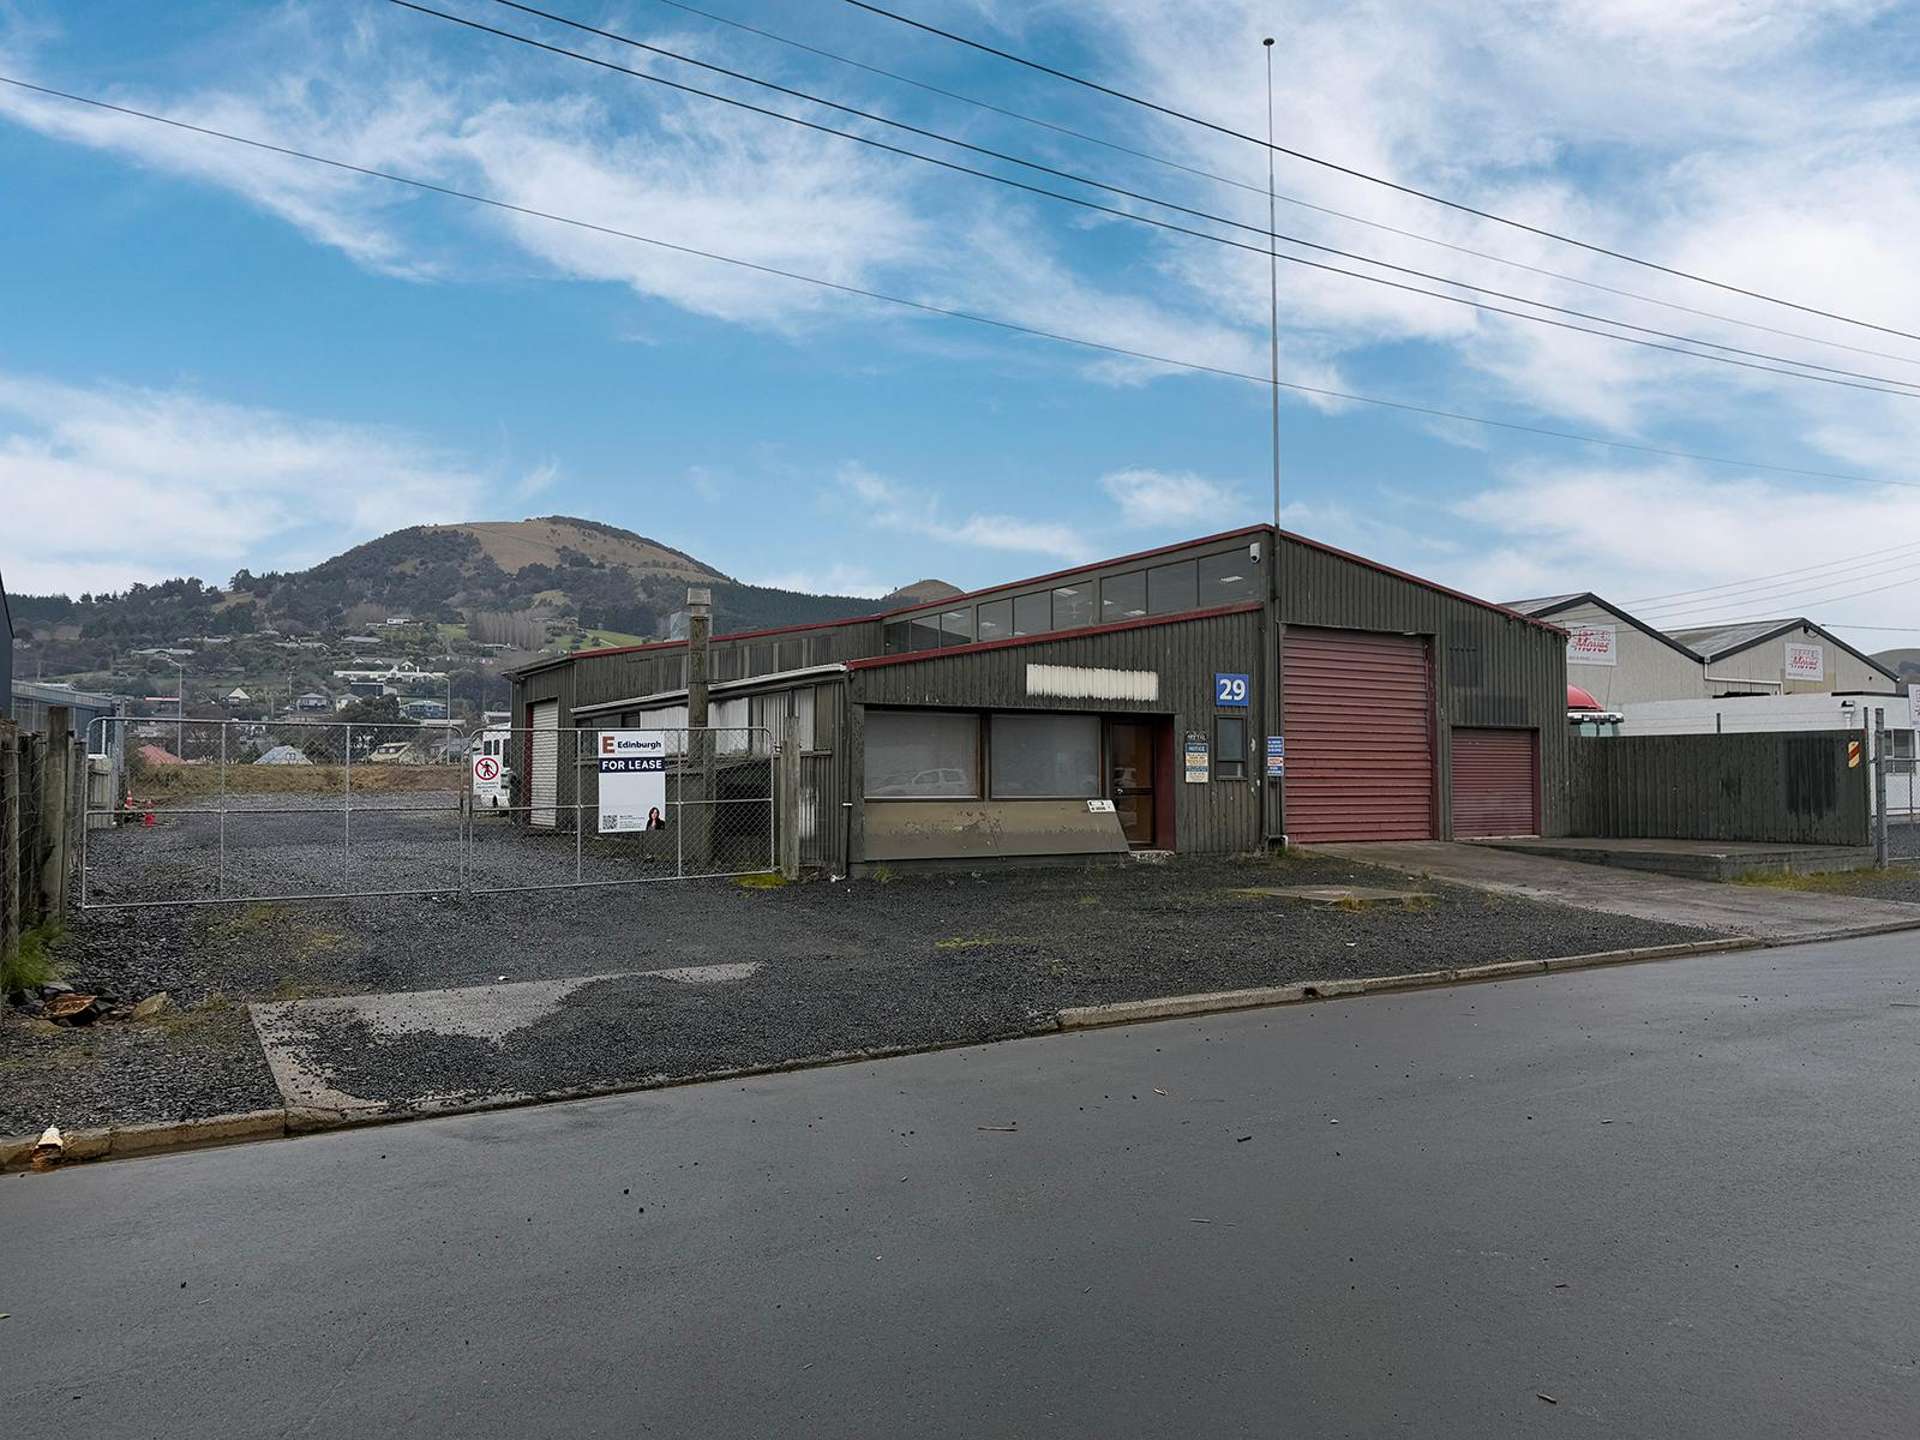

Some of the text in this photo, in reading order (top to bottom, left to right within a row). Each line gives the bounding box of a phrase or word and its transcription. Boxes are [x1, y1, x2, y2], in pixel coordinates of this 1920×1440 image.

[1219, 679, 1246, 701] 29
[602, 736, 615, 753] E
[617, 741, 662, 750] Edinburgh
[602, 760, 662, 770] FOR LEASE
